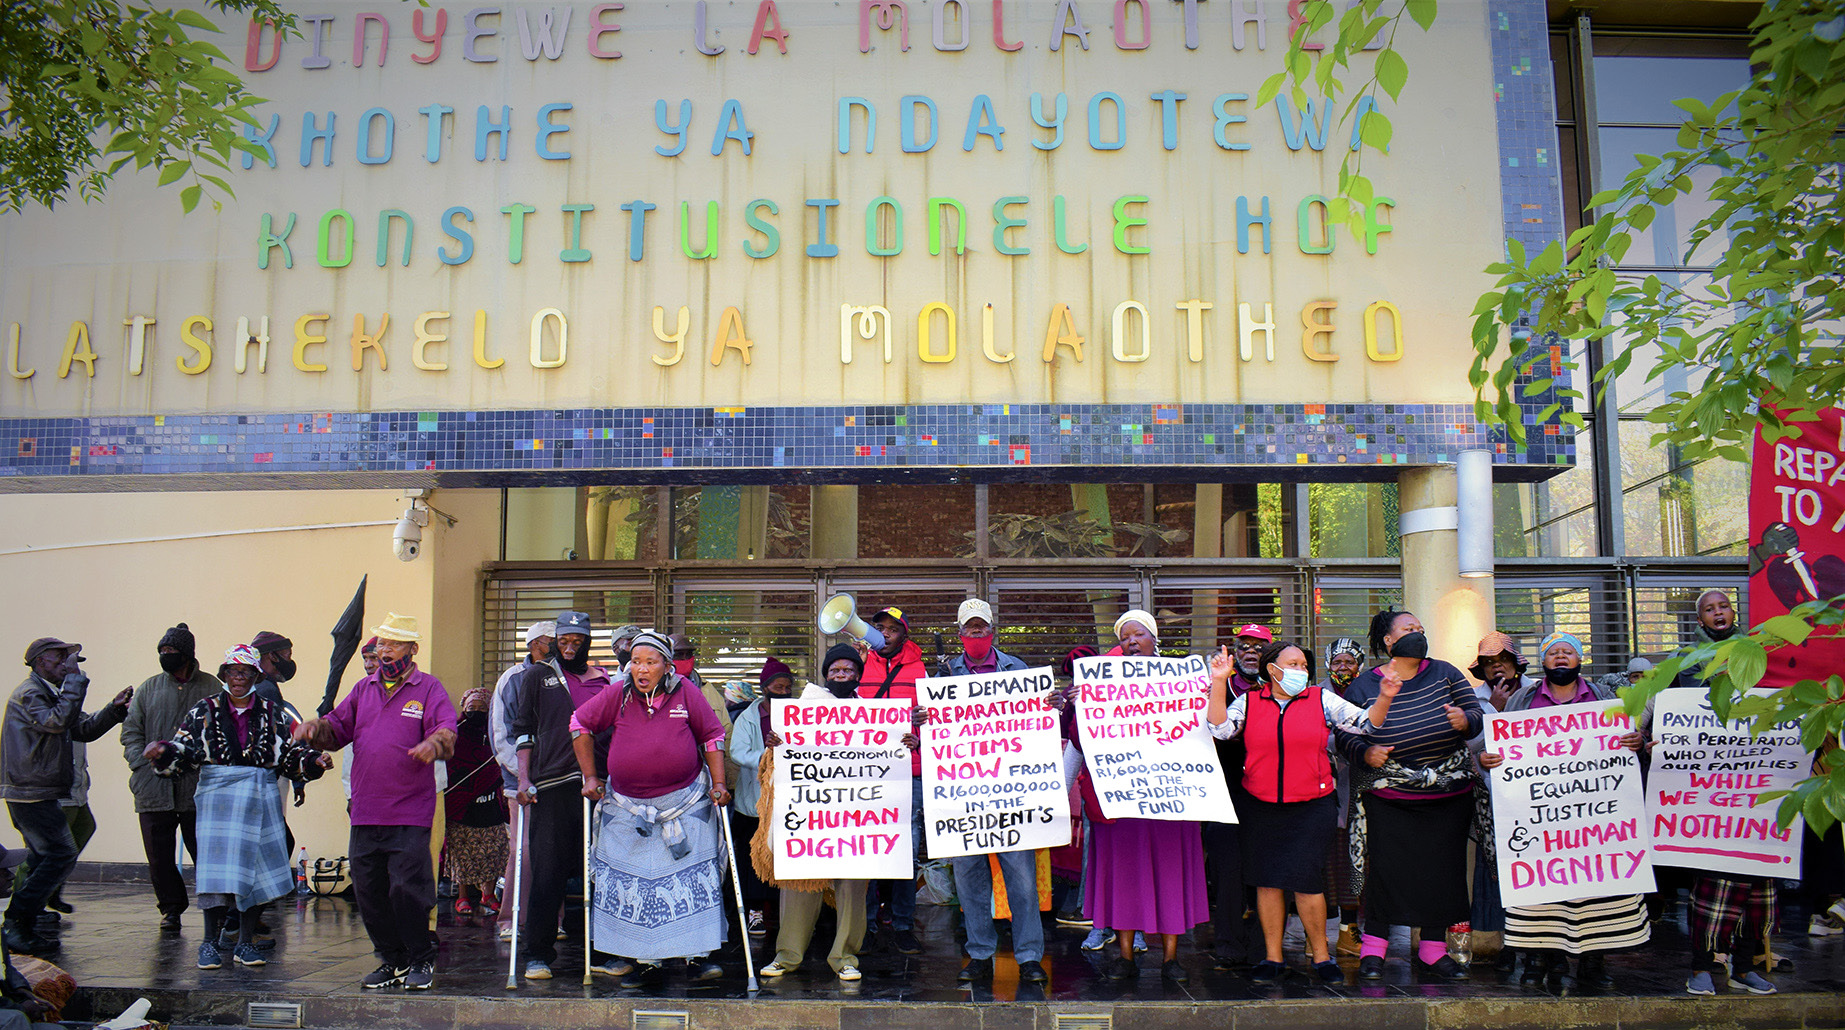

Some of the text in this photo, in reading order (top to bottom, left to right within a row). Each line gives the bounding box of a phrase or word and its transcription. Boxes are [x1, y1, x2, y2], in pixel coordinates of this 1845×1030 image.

[245, 3, 625, 72] DINYEWE
[694, 0, 789, 55] LA
[241, 103, 573, 170] KHOTHE
[654, 98, 754, 157] YA
[256, 193, 1397, 270] KONSTITUSIONELE HOF
[7, 299, 1404, 378] LATSHEKELO YA MOLAOTHEO
[1774, 485, 1823, 526] TO
[1080, 658, 1204, 679] WE DEMAND
[926, 674, 1053, 701] WE DEMAND
[1080, 675, 1209, 703] REPARATIONS
[783, 704, 913, 727] REPARATION
[928, 697, 1054, 725] REPARATIONS
[1083, 697, 1207, 720] TO APARTHEID
[784, 729, 888, 747] IS KEY TO
[930, 716, 1055, 741] TO APARTHEID
[1087, 712, 1200, 746] VICTIMS NOW
[1492, 711, 1630, 742] REPARATION
[931, 736, 1023, 761] VICTIMS
[1498, 734, 1623, 761] IS KEY TO
[1661, 733, 1694, 746] FOR
[783, 749, 906, 761] SOCIO-ECONOMIC
[1094, 750, 1142, 766] FROM
[1660, 759, 1800, 771] OUR FAMILIES
[1663, 747, 1773, 760] WHO KILLED
[790, 763, 891, 783] EQUALITY
[937, 757, 1057, 781] NOW FROM
[1095, 762, 1214, 779] R1,600,000,000
[1502, 755, 1635, 782] SOCIO-ECONOMIC
[1690, 772, 1774, 789] WHILE
[1104, 785, 1207, 803] PRESIDENT'S
[1130, 775, 1184, 788] IN THE
[1530, 774, 1624, 801] EQUALITY
[790, 785, 884, 804] JUSTICE
[1659, 790, 1759, 808] WE GET
[808, 807, 899, 831] HUMAN
[1138, 799, 1185, 816] FUND
[1530, 800, 1618, 825] JUSTICE
[935, 805, 1054, 836] PRESIDENT'S
[1653, 812, 1792, 842] NOTHING
[786, 833, 900, 859] DIGNITY
[963, 829, 1021, 851] FUND
[1543, 817, 1637, 853] HUMAN
[1511, 849, 1646, 890] DIGNITY
